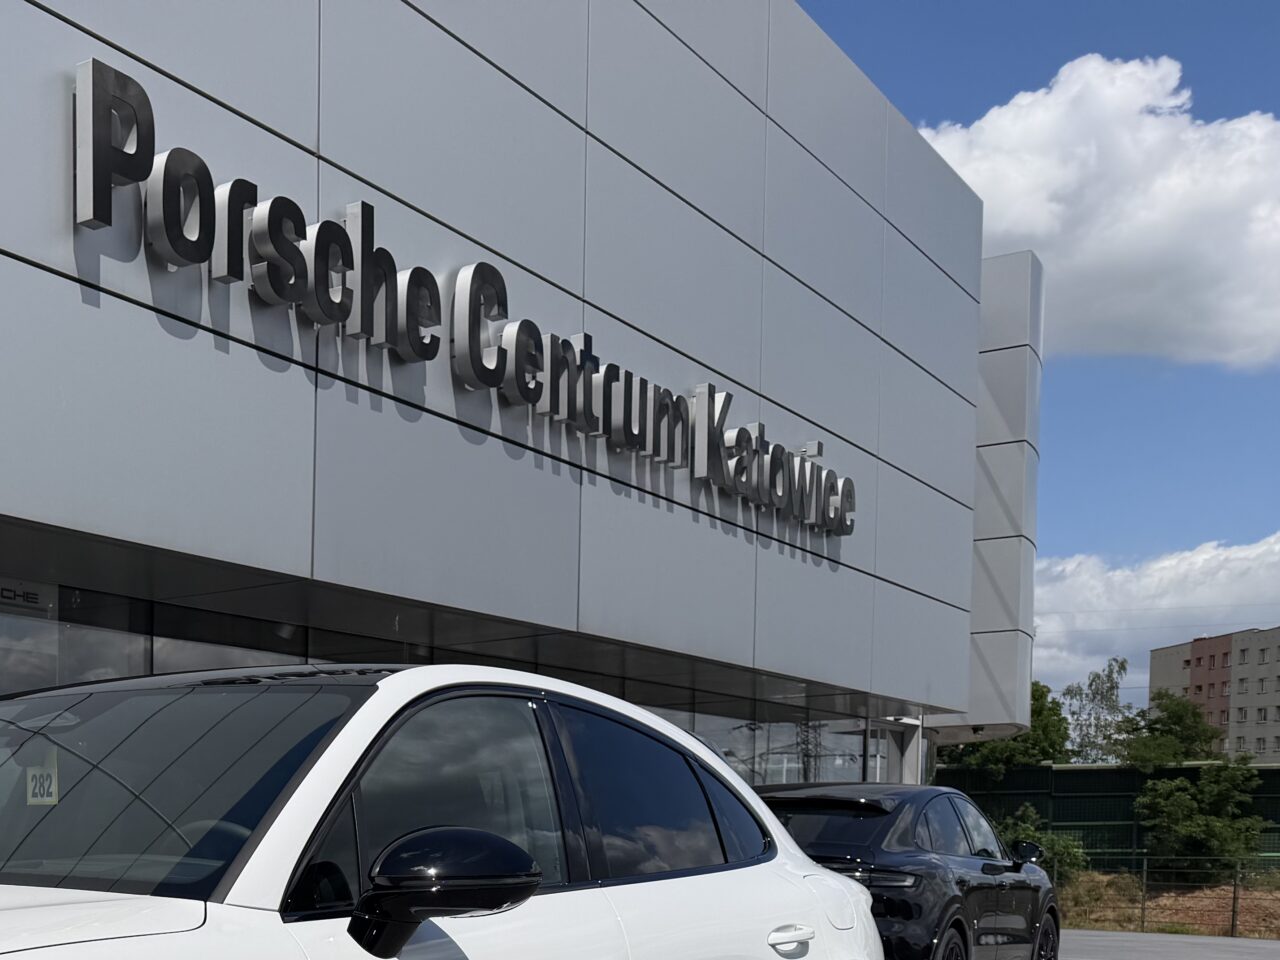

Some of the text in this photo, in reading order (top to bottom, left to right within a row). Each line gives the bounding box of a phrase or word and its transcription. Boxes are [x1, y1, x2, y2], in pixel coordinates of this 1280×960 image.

[74, 57, 857, 537] Porsche Centrum Katowice
[31, 773, 53, 798] 282
